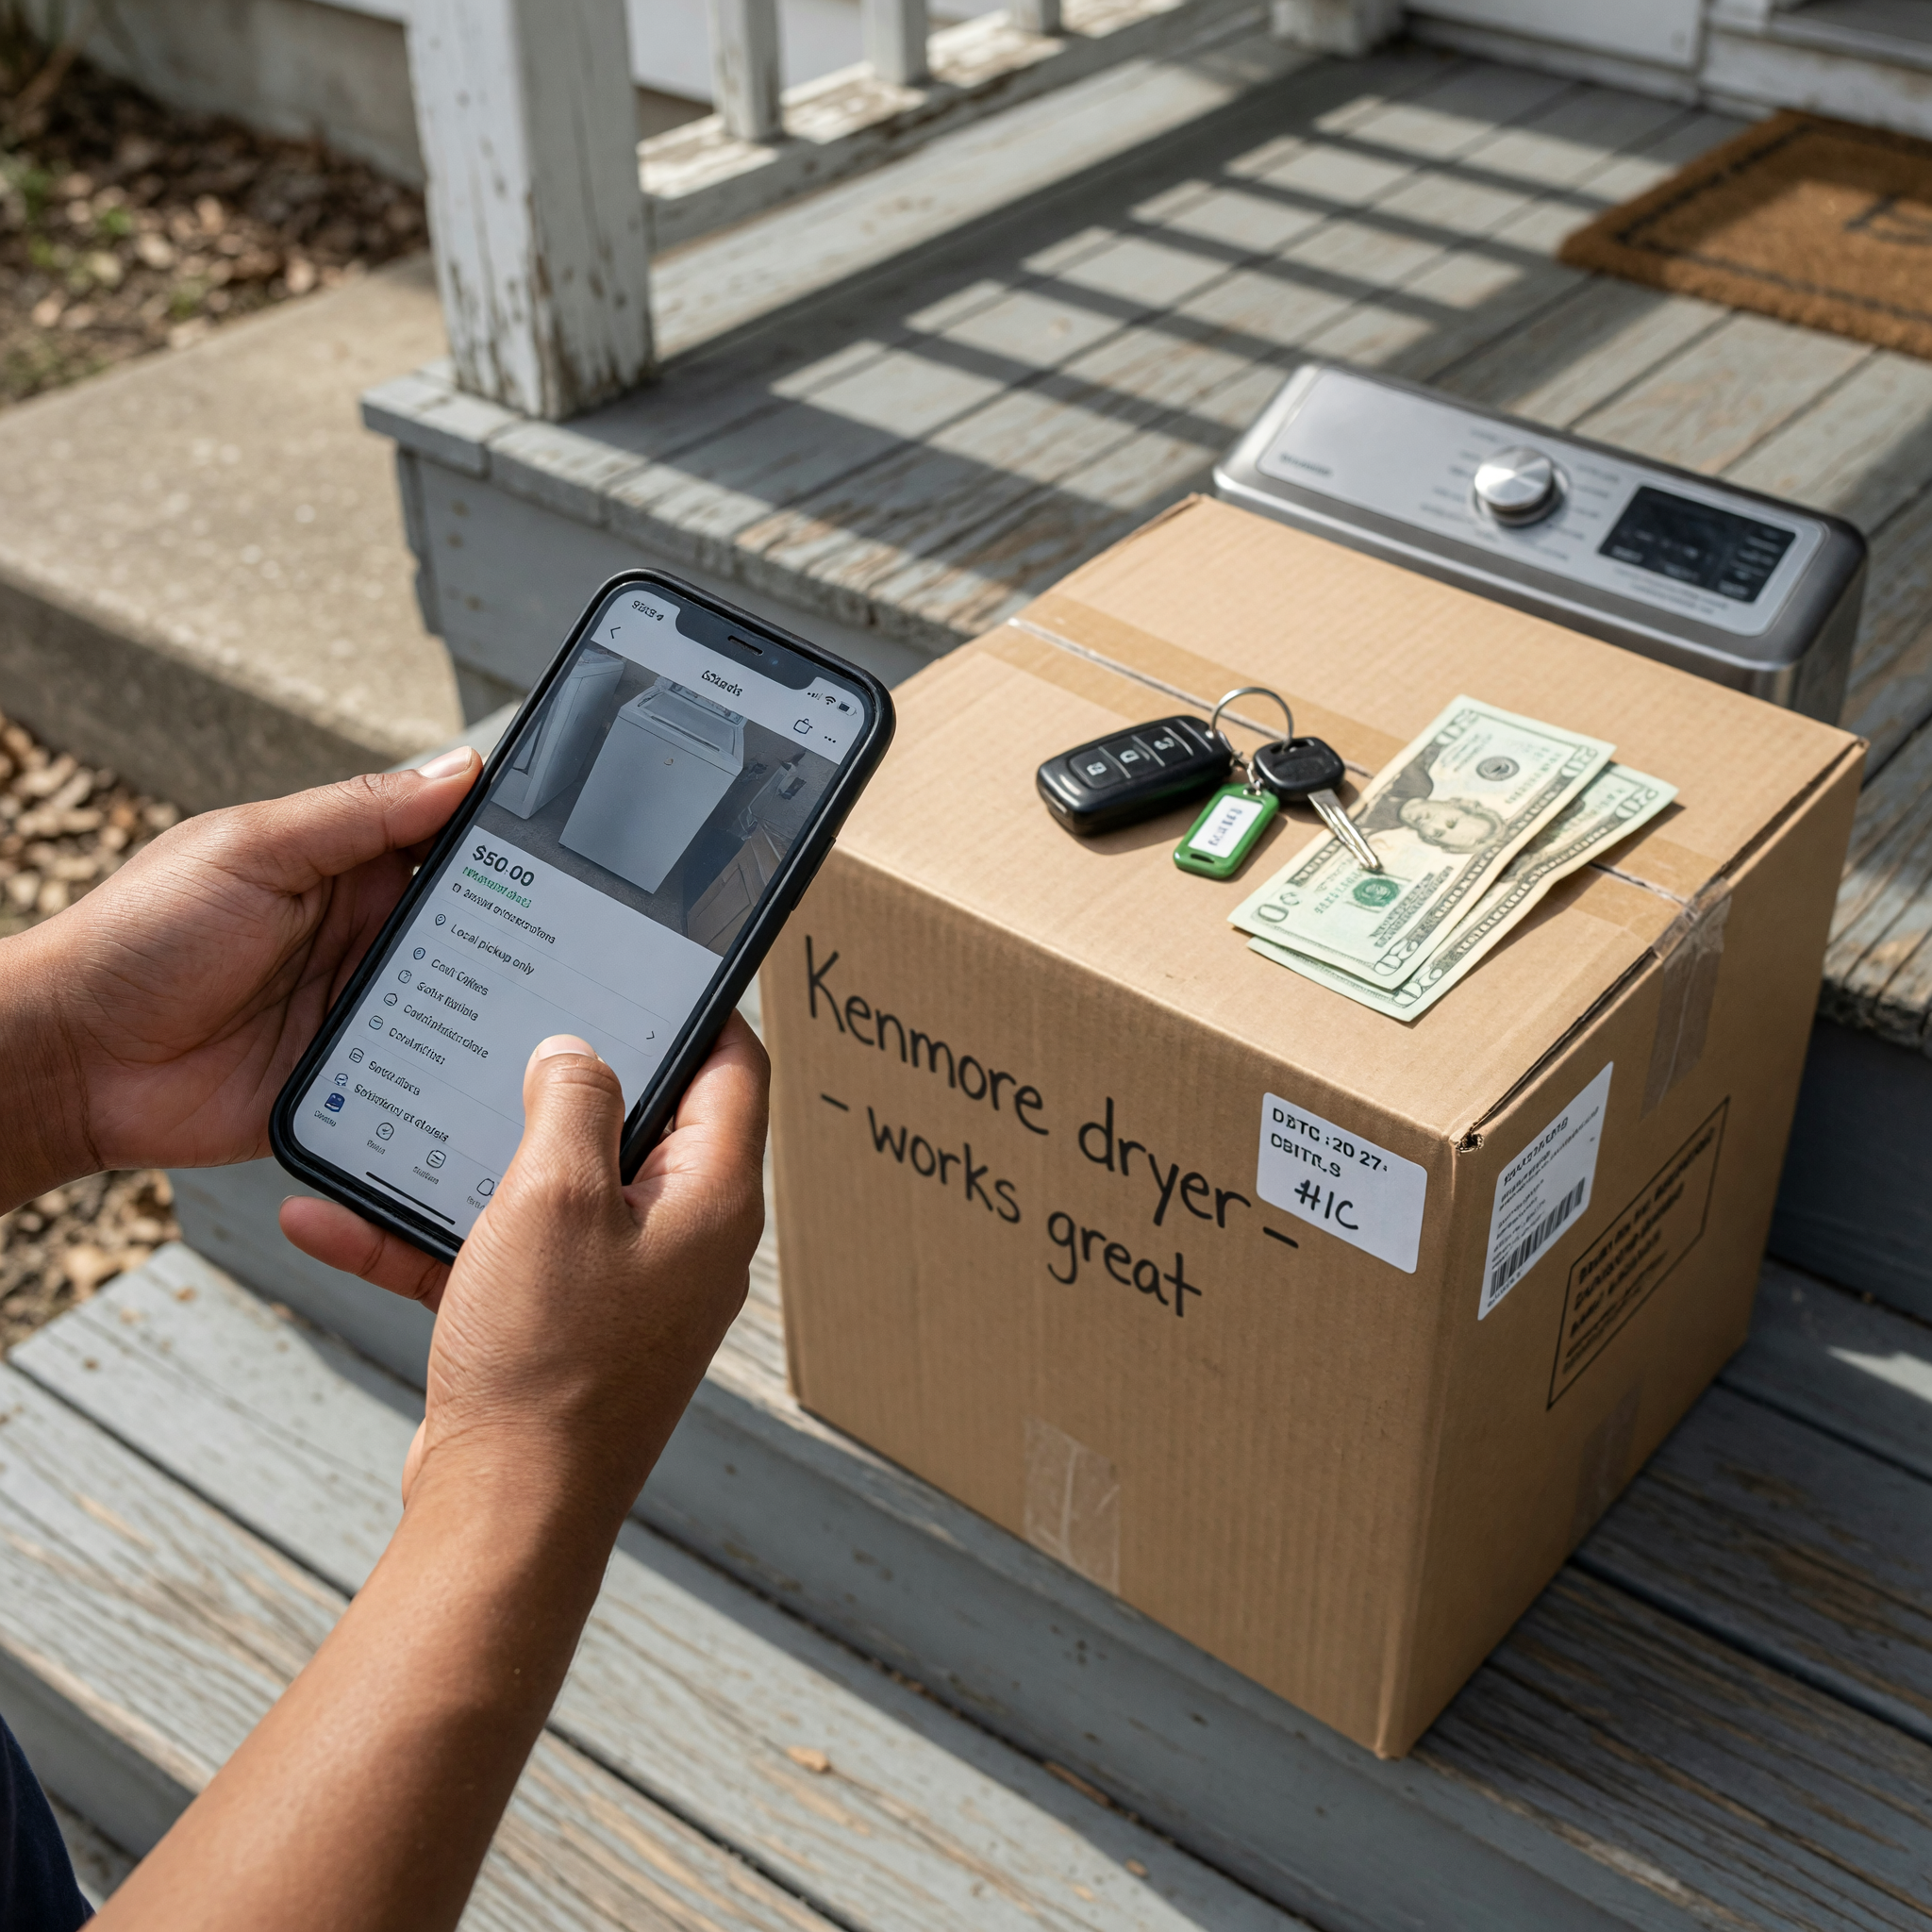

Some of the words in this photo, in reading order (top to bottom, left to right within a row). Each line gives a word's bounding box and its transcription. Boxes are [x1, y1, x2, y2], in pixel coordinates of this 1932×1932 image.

[473, 844, 535, 887] $50.00
[451, 924, 479, 944] Local
[477, 940, 512, 963] pickup
[512, 958, 535, 975] only
[805, 934, 1050, 1136] Kenmore
[1078, 1096, 1252, 1228] dryer
[867, 1105, 1022, 1224] works
[1047, 1211, 1203, 1318] great
